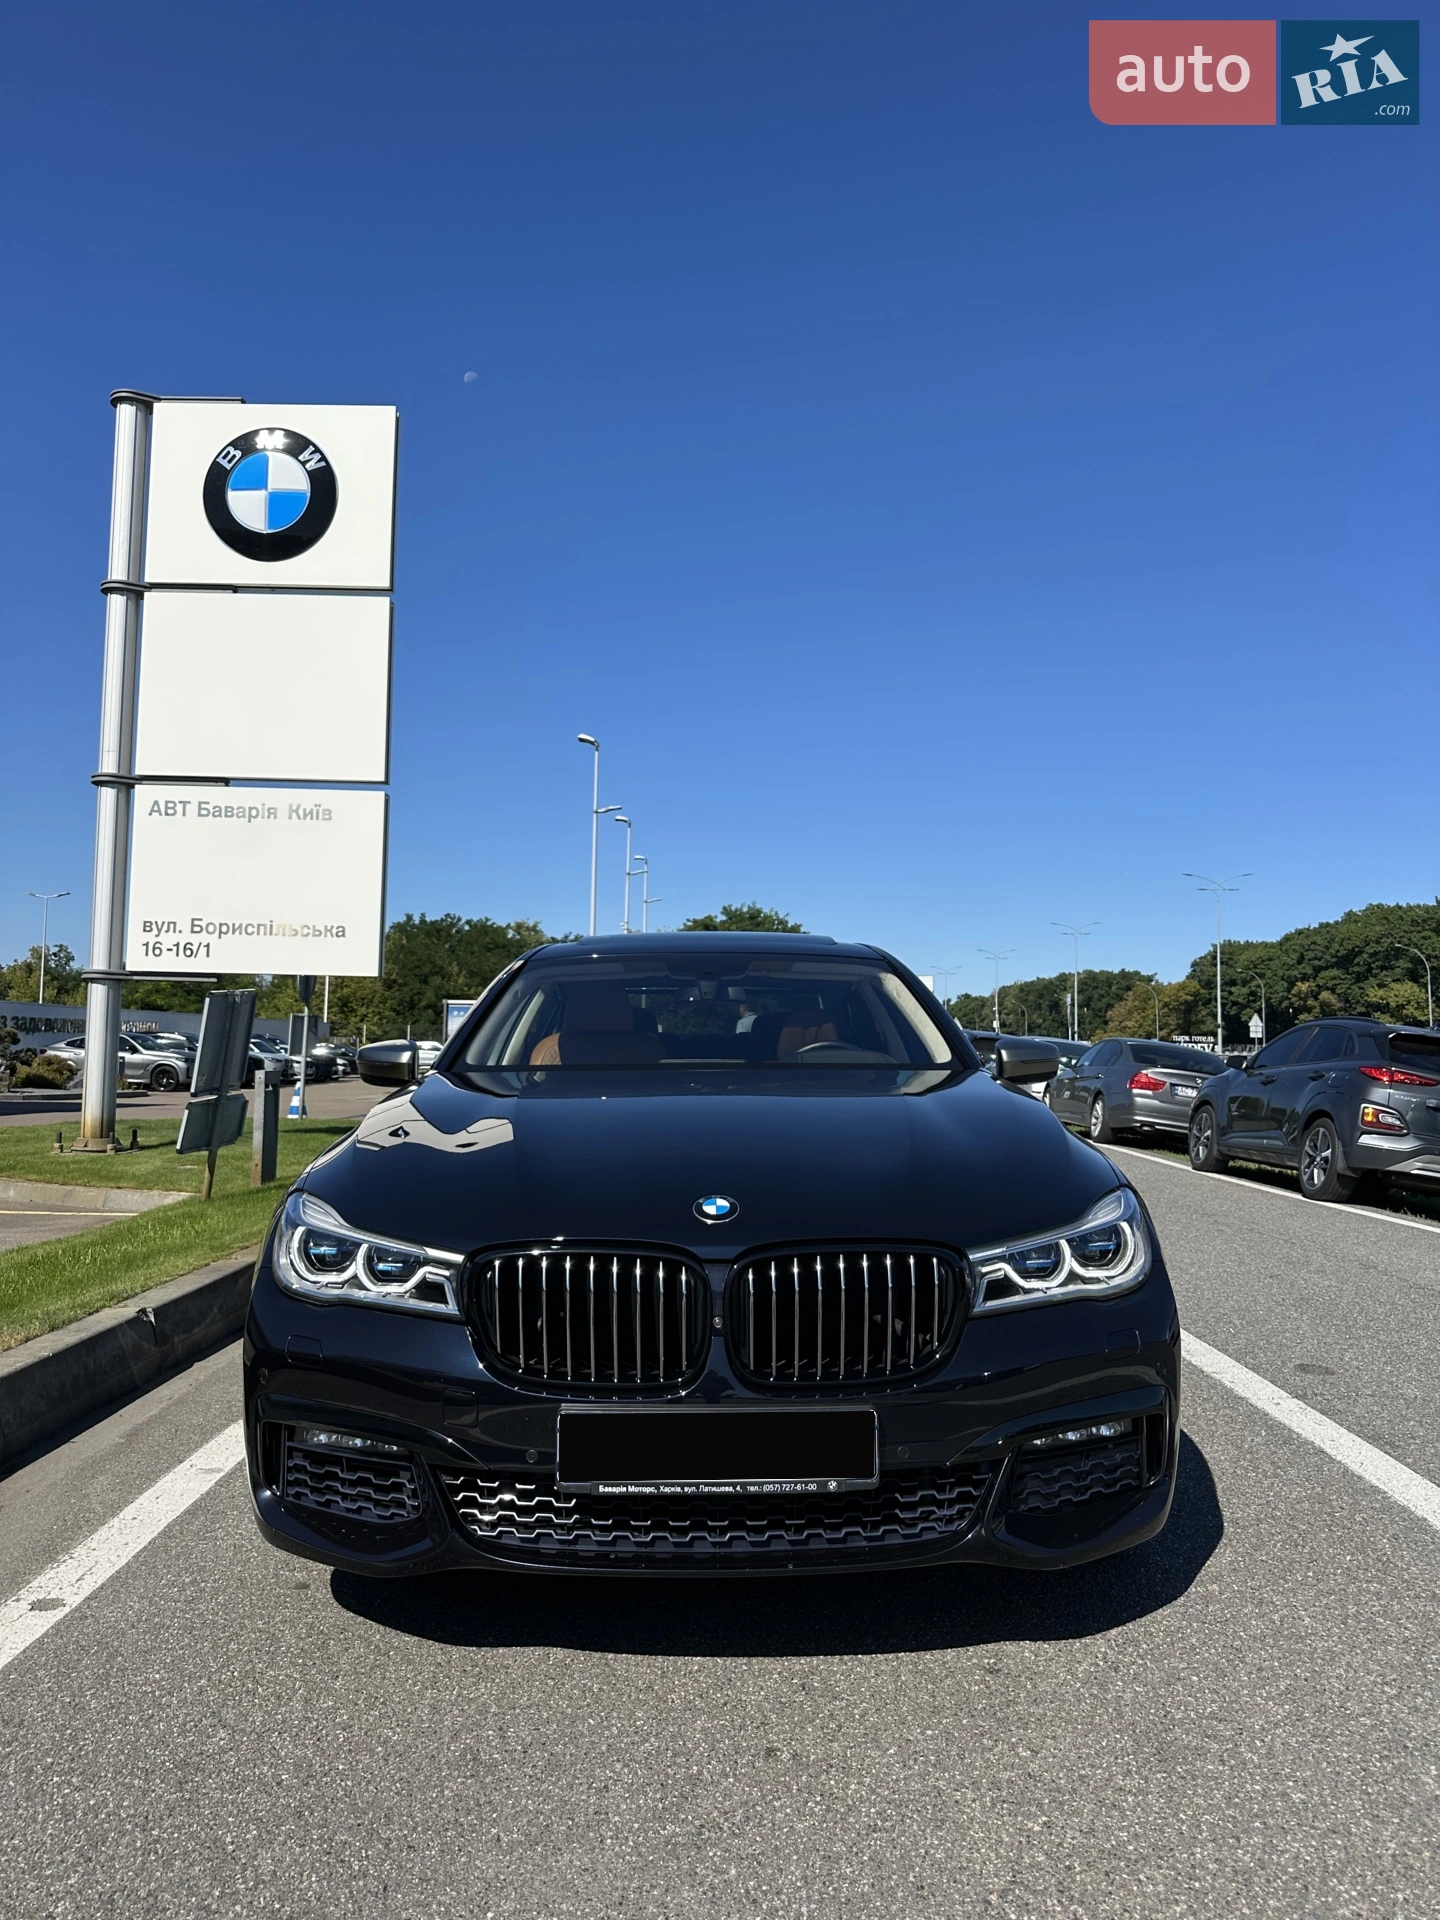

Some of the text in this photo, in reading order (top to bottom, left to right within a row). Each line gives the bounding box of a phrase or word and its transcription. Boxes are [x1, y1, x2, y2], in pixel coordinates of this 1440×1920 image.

[216, 429, 326, 471] BMW
[148, 799, 333, 823] АВТ Баварія Київ
[142, 917, 346, 940] вул. Бориспільська
[141, 941, 212, 958] 16-16/1
[599, 1485, 627, 1494] Баварія
[628, 1485, 658, 1494] Моторс,
[660, 1485, 683, 1493] Харків,
[699, 1485, 735, 1493] Латишева,
[763, 1483, 781, 1493] (057)
[782, 1483, 818, 1491] 727-61-00
